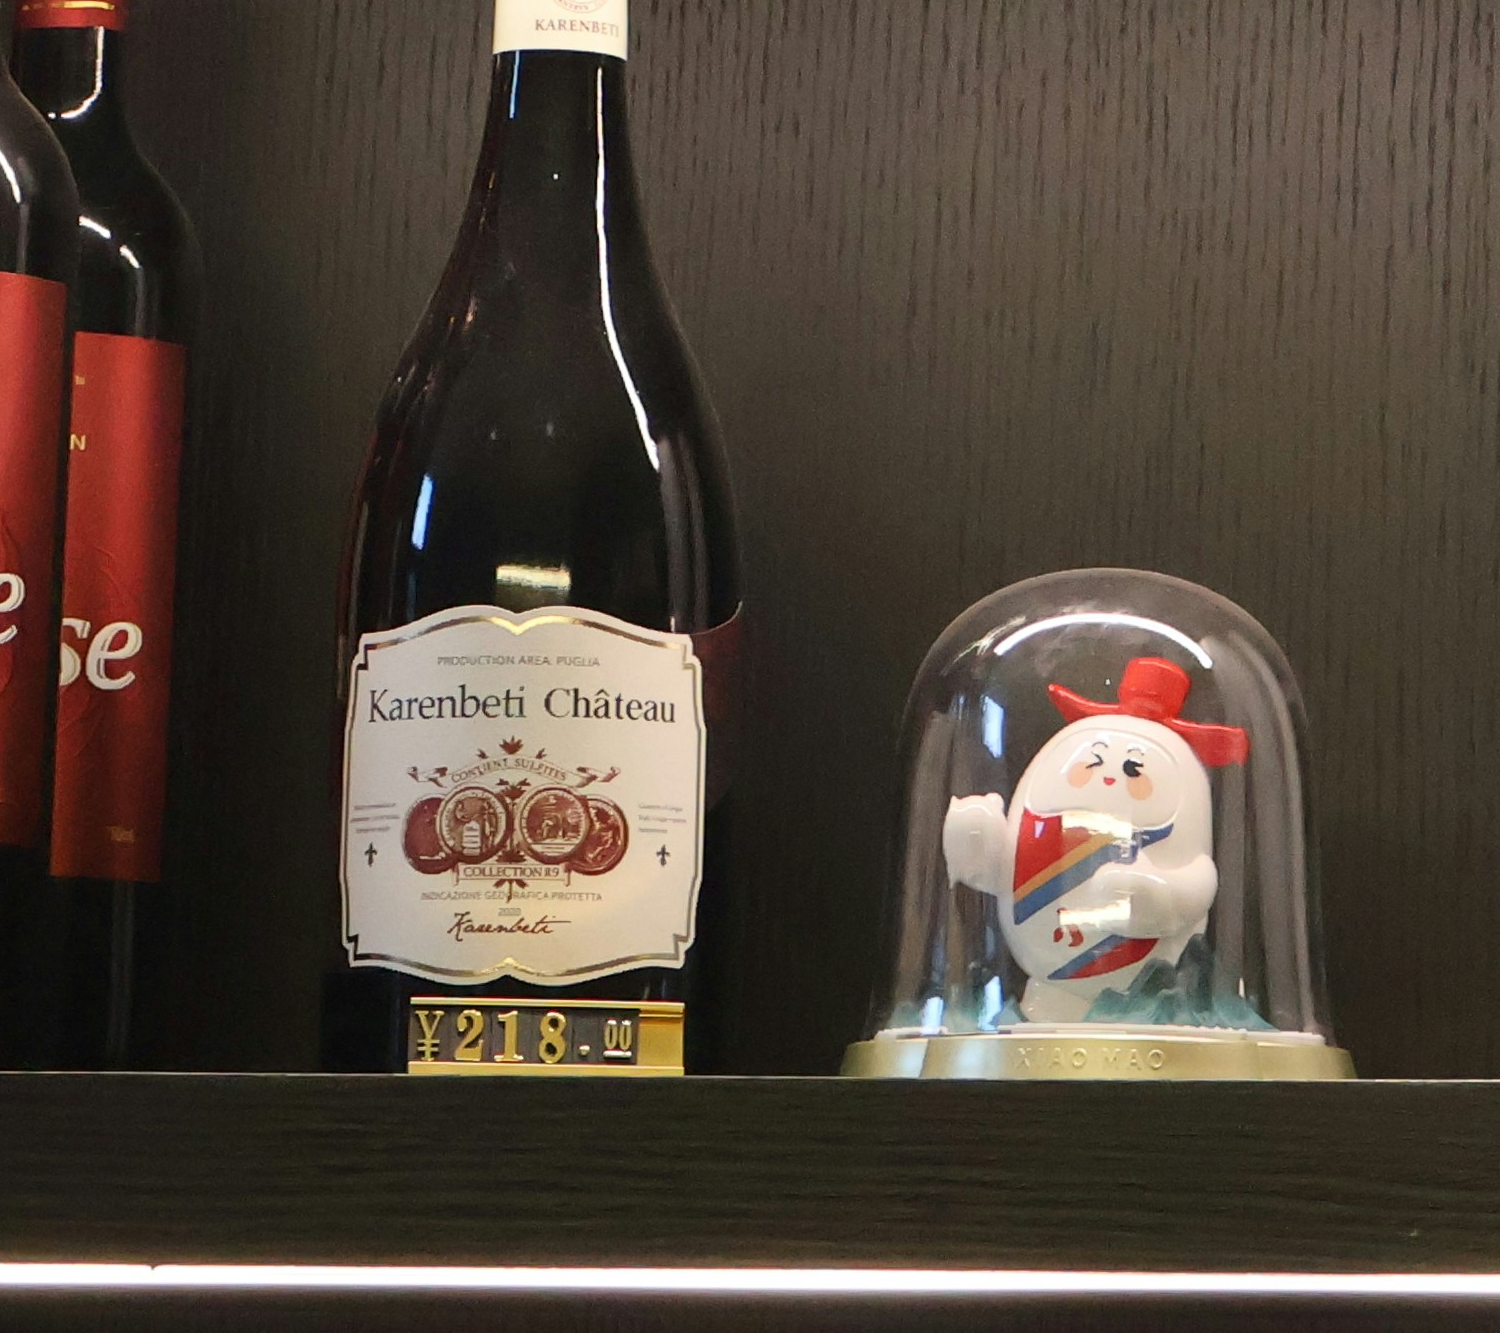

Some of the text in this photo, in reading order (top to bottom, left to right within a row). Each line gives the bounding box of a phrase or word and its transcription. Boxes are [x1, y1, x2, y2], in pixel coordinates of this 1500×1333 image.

[535, 19, 619, 37] KARENBETI
[437, 657, 600, 667] PRODUCTION PUGLIA
[369, 685, 676, 723] Karenbeti Château
[515, 758, 566, 781] SULFITES
[463, 867, 542, 877] COLLECTION
[552, 893, 602, 901] PROTETTA
[447, 912, 571, 941] Karenbeti
[415, 1009, 633, 1062] ¥218.00
[1017, 1047, 1165, 1071] XIAO MAO
